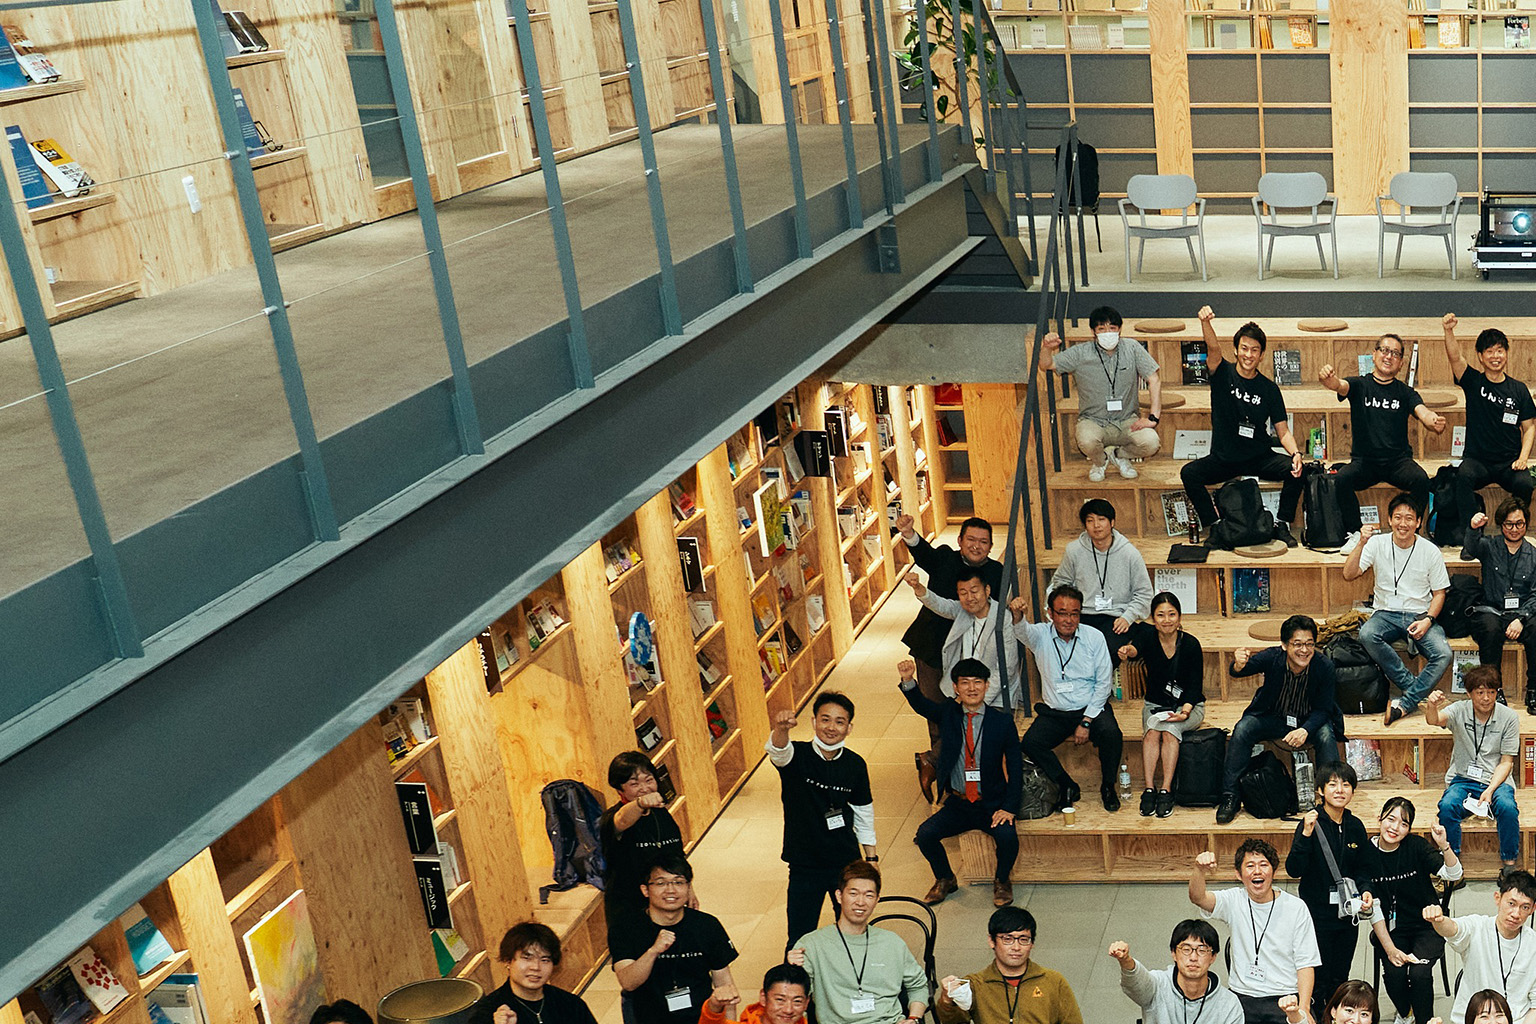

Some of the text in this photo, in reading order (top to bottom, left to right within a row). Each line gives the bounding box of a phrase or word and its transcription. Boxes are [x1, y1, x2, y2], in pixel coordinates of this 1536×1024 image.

[1364, 396, 1401, 409] しんとみ
[1157, 575, 1175, 583] the
[1157, 581, 1187, 590] north
